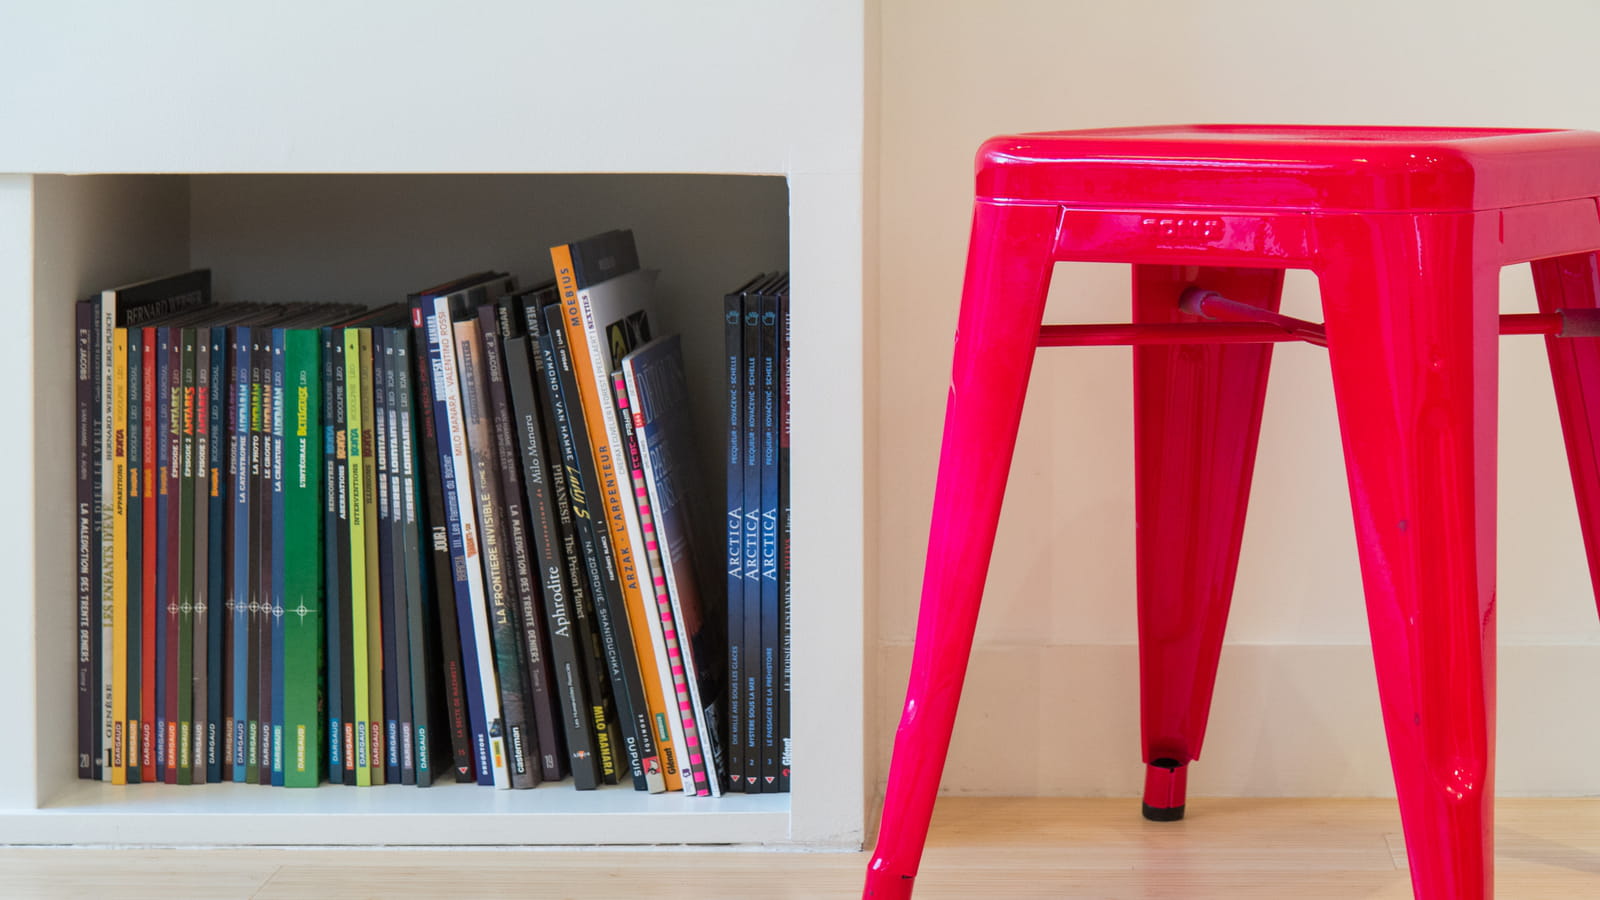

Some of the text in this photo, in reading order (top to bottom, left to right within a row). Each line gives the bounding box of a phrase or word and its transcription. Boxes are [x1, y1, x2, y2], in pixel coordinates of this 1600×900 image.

[560, 268, 580, 326] MOEBIUS
[582, 295, 594, 329] SEXTIES
[525, 307, 544, 370] HEAVY METAL
[589, 335, 604, 373] PEELLAERT
[438, 312, 462, 456] MILO MANARA VALENTINO ROSSI
[487, 352, 499, 381] JACOBS
[556, 401, 568, 421] VAN
[599, 379, 610, 405] FOREST
[377, 408, 386, 470] LOINTAINES
[390, 410, 399, 473] LOINTAINES
[401, 411, 412, 475] LOINTAINES
[558, 426, 573, 461] HAMME
[606, 409, 619, 443] CUVELIER
[95, 460, 101, 474] LE
[253, 464, 259, 474] LA
[265, 468, 271, 478] LE
[275, 482, 281, 491] LA
[81, 503, 88, 515] LA
[240, 493, 245, 502] LA
[380, 473, 388, 518] TERRES
[392, 476, 401, 522] TERRES
[405, 478, 414, 524] TERRES
[447, 480, 460, 535] Les Flammes du
[599, 445, 636, 589] ARZAK L'ARPENTEUR
[434, 532, 448, 552] JOUR
[524, 415, 569, 637] Aphrodite Illustrations Milo Manara
[552, 464, 584, 618] PIRANESE The Prison Planet
[728, 507, 742, 579] ARCTICA
[745, 508, 759, 580] ARCTICA
[762, 508, 776, 580] ARCTICA
[481, 494, 506, 623] LA FRONTIERE INVISIBLE
[102, 544, 113, 627] LES ENFANTS
[510, 504, 539, 662] LA DES TRENTE DENIERS
[585, 541, 619, 675] NA SHANIOUCHKA
[81, 630, 89, 662] DENIERS
[450, 661, 459, 696] NAZARETH
[419, 728, 427, 768] DARGAUD
[478, 733, 488, 775] DRUGSTORE
[511, 727, 525, 772] casterman
[593, 706, 613, 775] MILO MANARA
[626, 737, 642, 776] DUPUIS
[664, 748, 676, 774] Glénat
